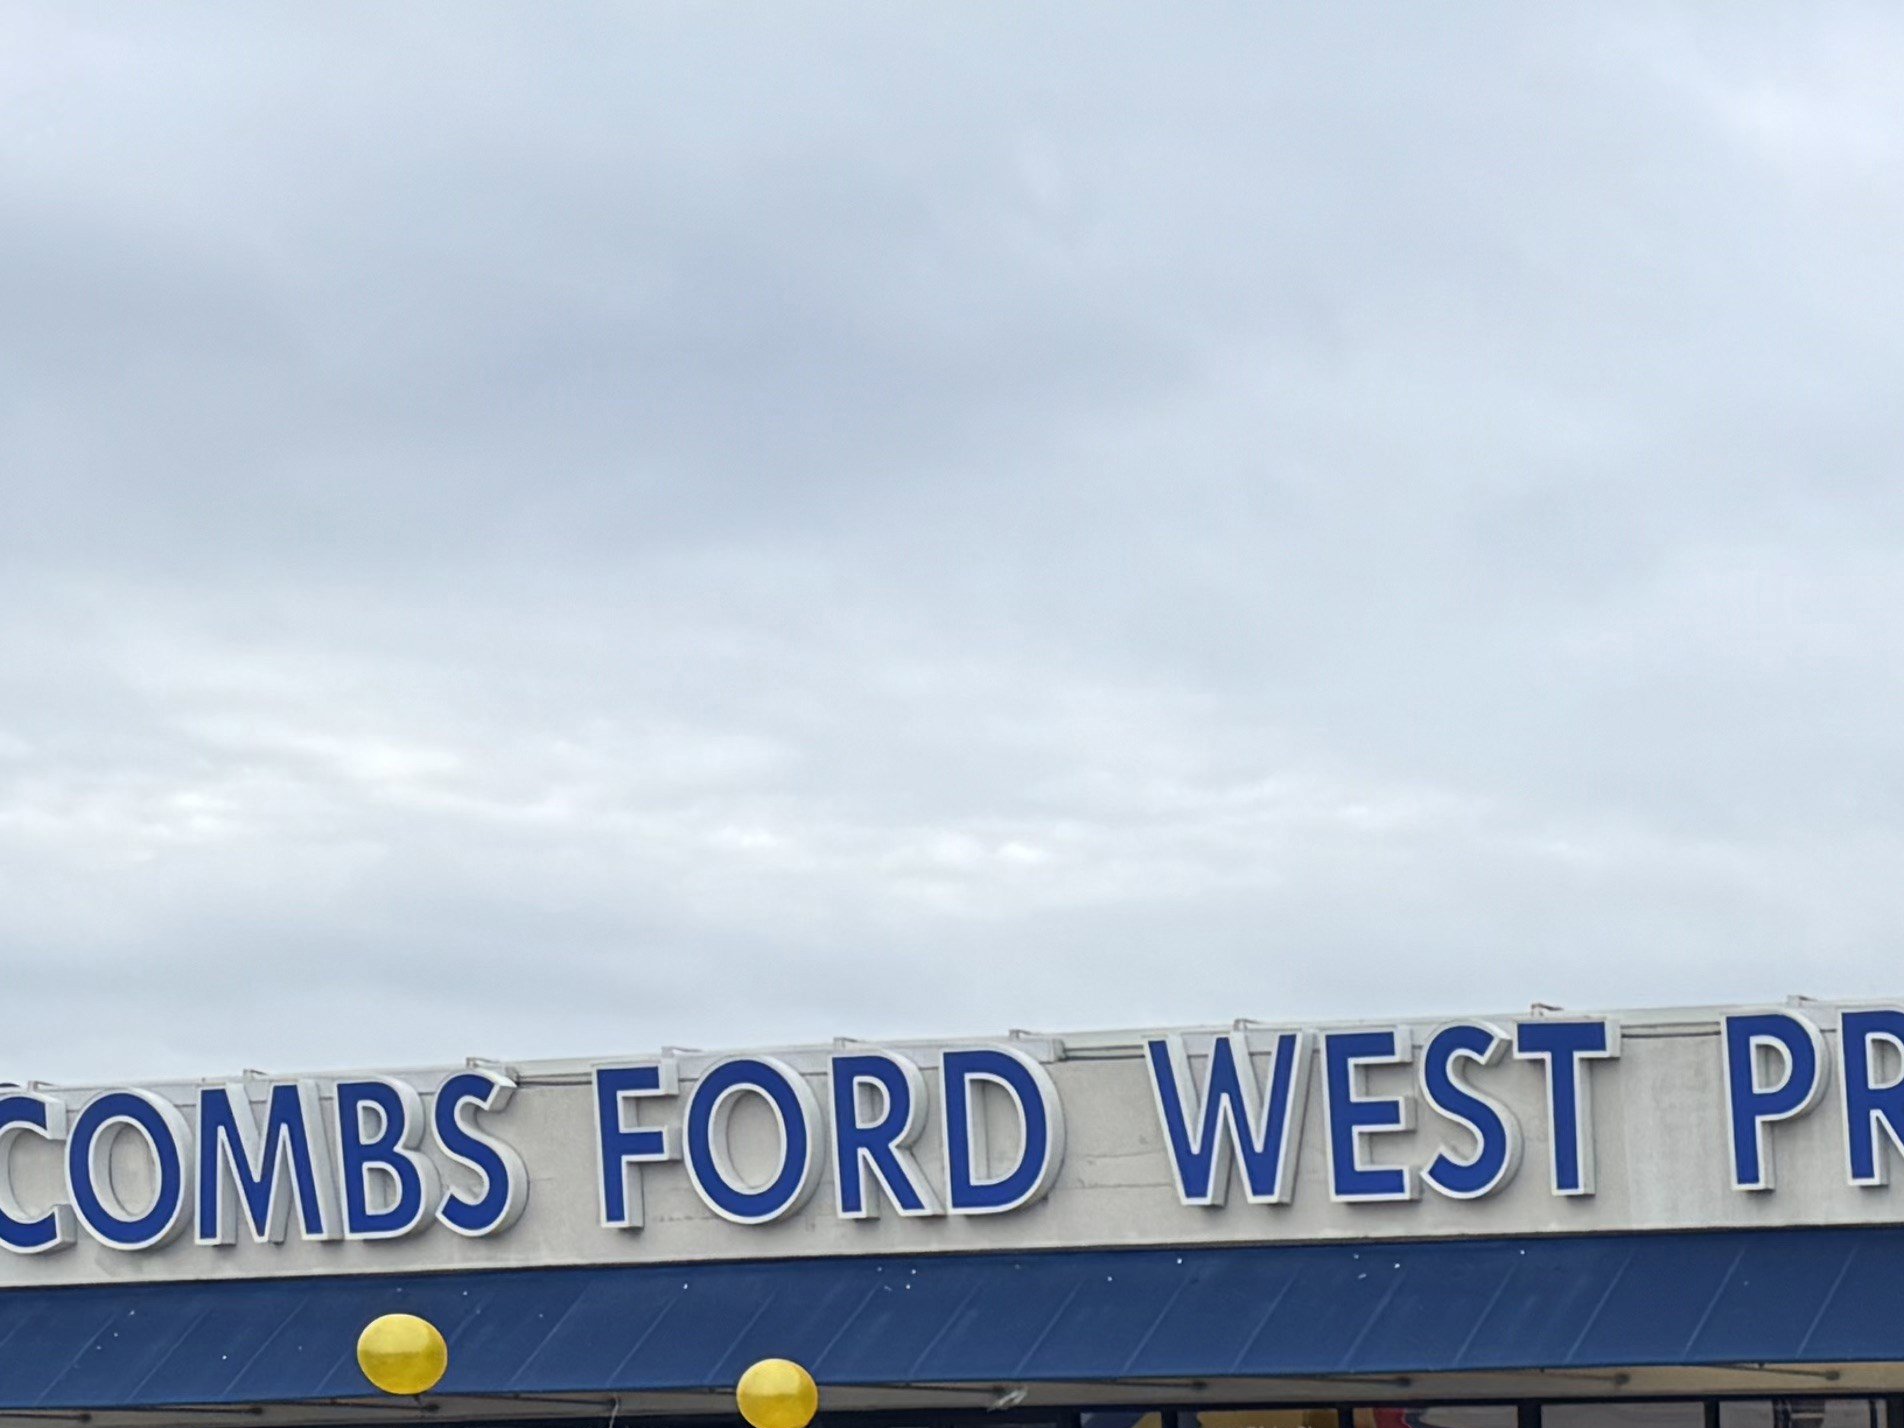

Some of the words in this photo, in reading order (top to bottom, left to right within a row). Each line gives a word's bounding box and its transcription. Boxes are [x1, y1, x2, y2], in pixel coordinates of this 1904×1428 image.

[0, 1072, 528, 1255] COMBS
[593, 1043, 1064, 1229] FORD
[1141, 1019, 1620, 1206] WEST
